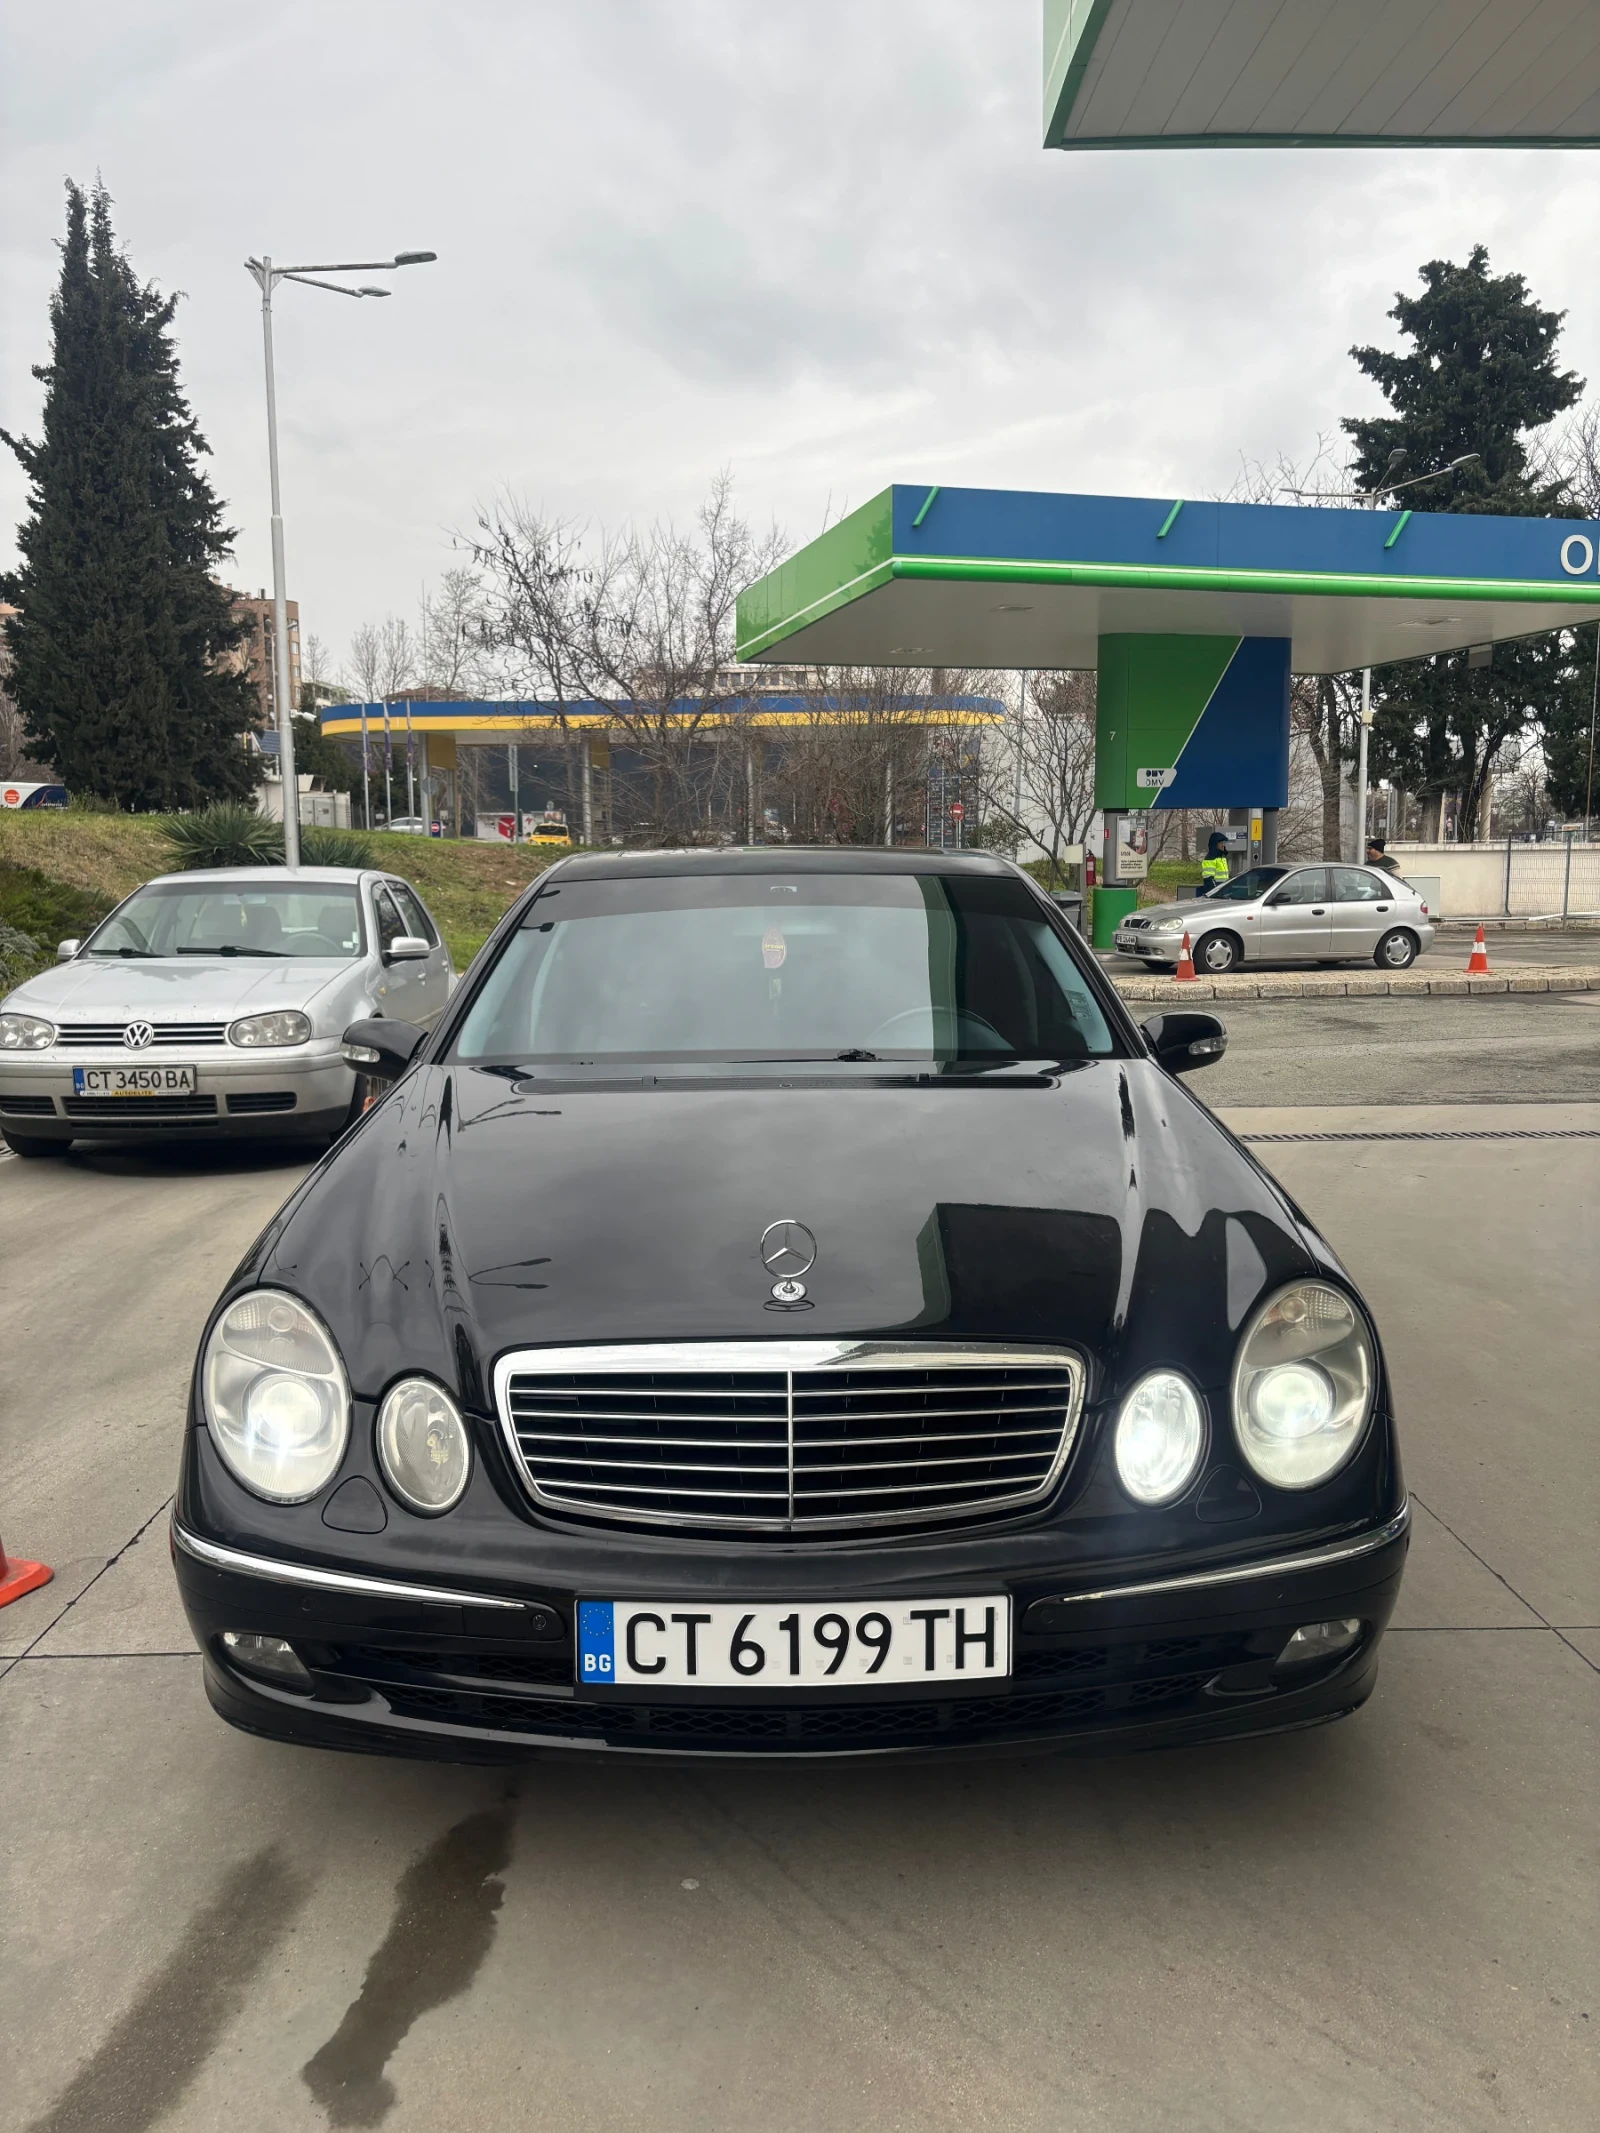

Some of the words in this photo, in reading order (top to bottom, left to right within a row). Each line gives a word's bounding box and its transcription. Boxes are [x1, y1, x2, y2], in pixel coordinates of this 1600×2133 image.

[1560, 534, 1600, 576] O
[1109, 730, 1117, 741] 7
[1145, 779, 1165, 787] OMV
[125, 1022, 152, 1048] VW
[86, 1071, 111, 1089] CT
[116, 1070, 162, 1089] 3450
[165, 1070, 191, 1088] BA
[583, 1653, 612, 1673] BG
[625, 1612, 712, 1675] CT
[728, 1611, 892, 1676] 6199
[909, 1606, 995, 1671] TH
